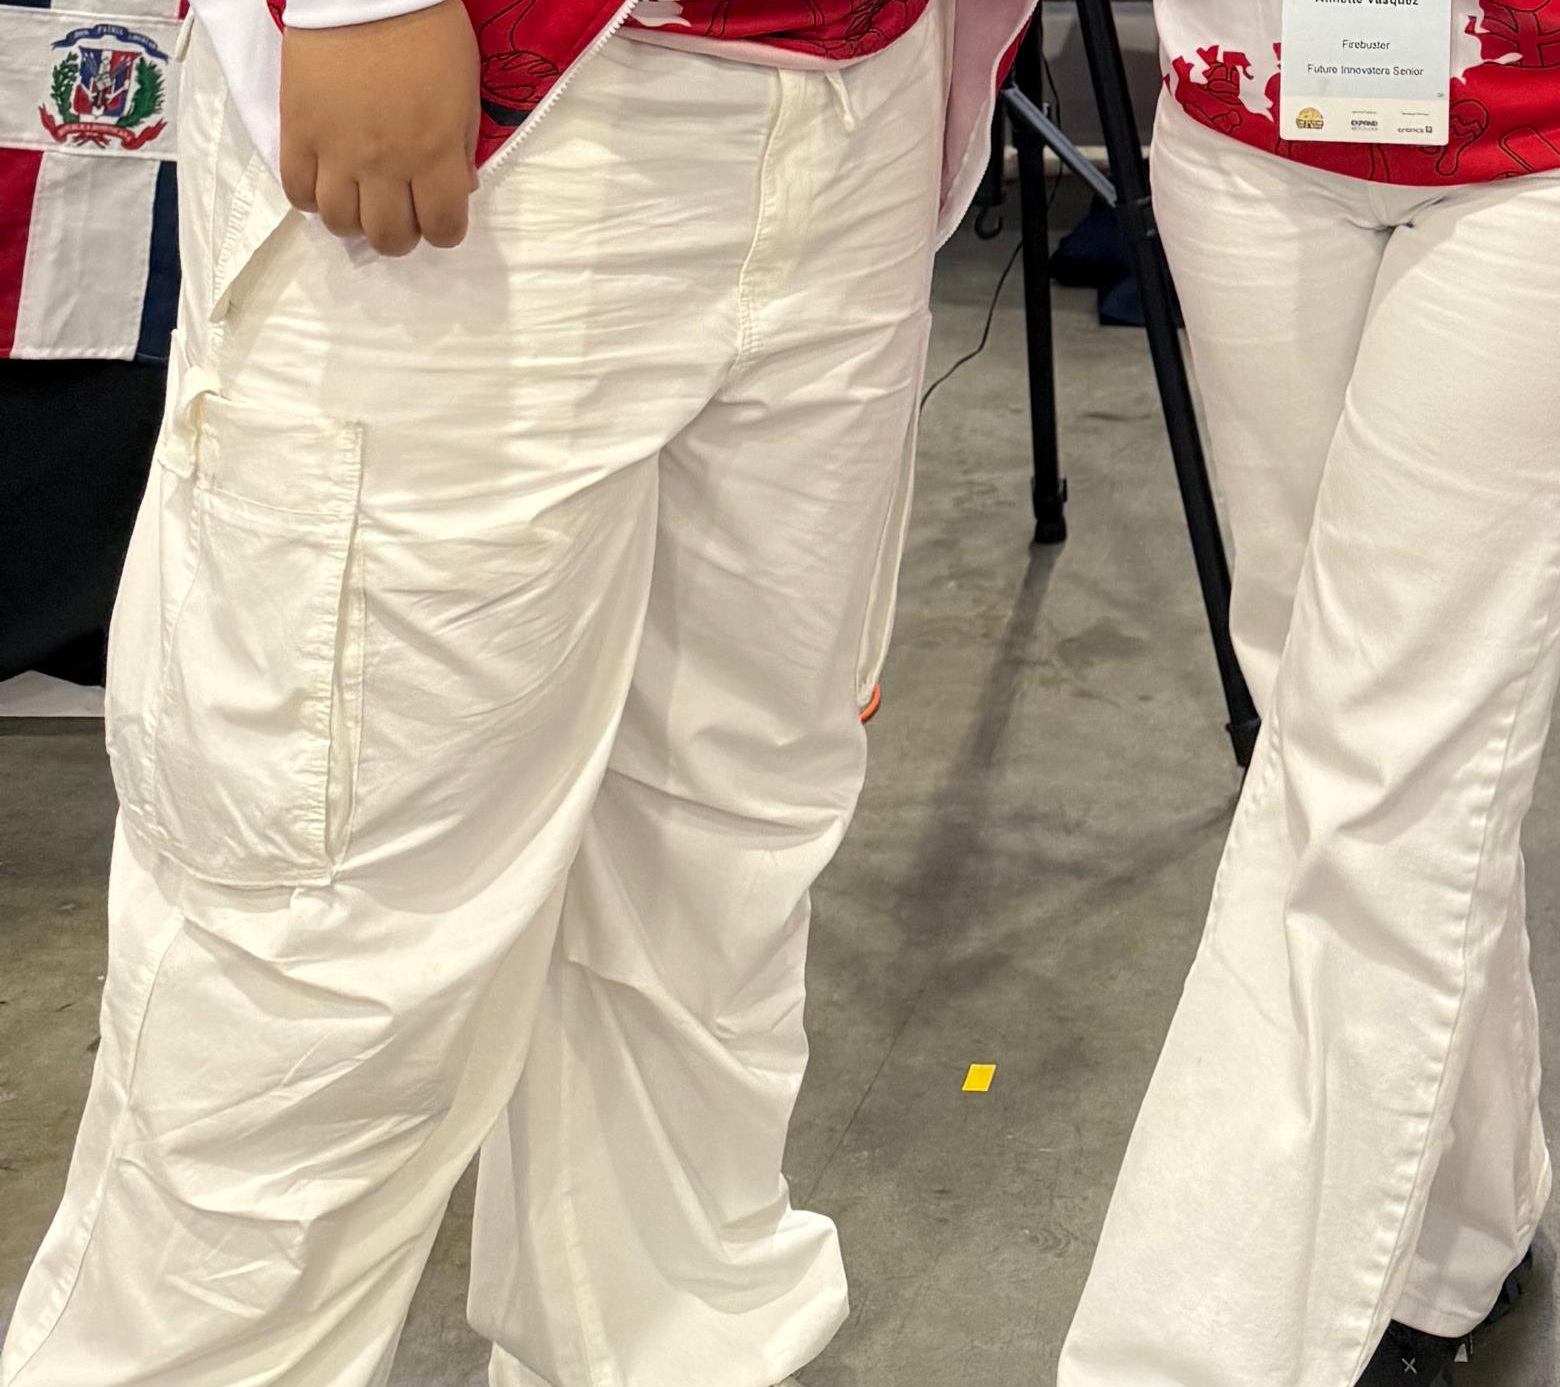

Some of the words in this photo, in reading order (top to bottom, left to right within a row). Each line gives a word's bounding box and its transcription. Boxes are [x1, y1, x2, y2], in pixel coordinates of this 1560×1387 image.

[1342, 39, 1391, 50] Firebuster
[1307, 63, 1338, 74] Future
[1341, 65, 1390, 75] Innovators
[1393, 66, 1424, 76] Senior
